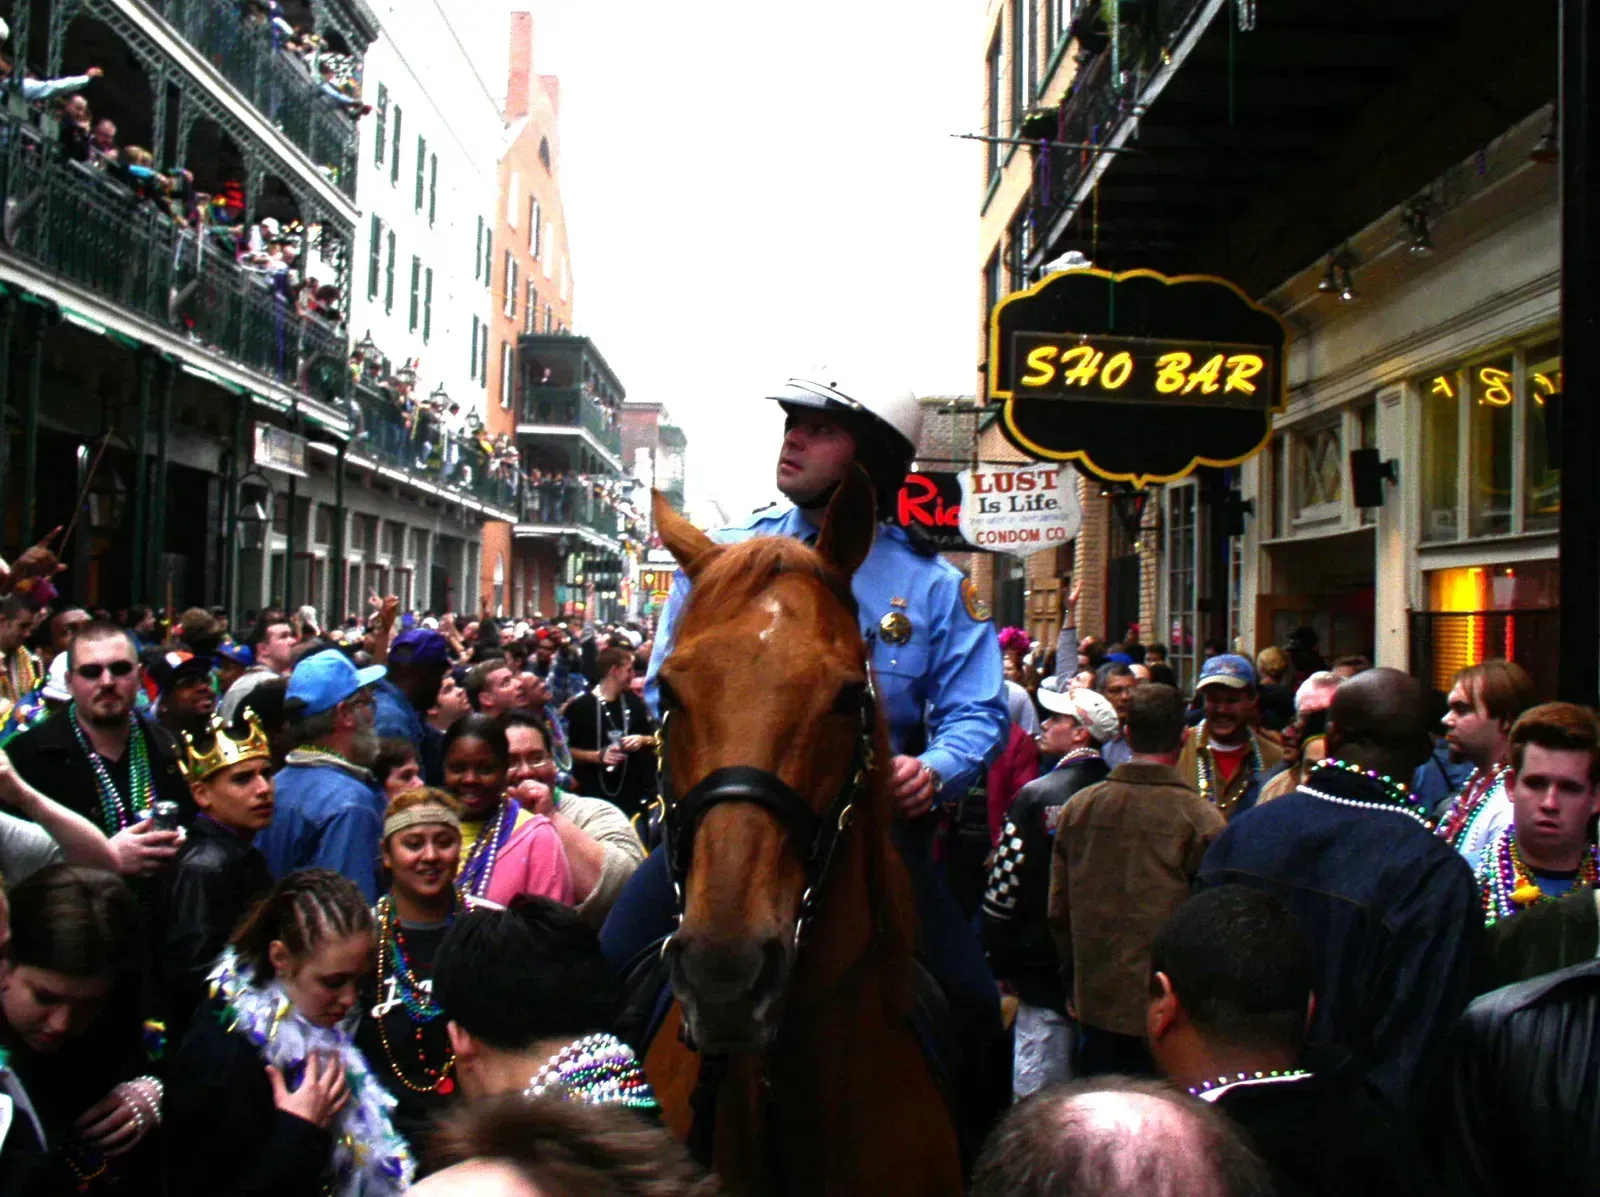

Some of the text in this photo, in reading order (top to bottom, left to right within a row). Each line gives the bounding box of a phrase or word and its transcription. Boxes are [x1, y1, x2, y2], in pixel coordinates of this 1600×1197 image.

[1021, 345, 1264, 396] SHO BAR
[971, 470, 1058, 494] LUST
[979, 498, 1000, 514] Is
[976, 529, 1040, 545] CONDOM
